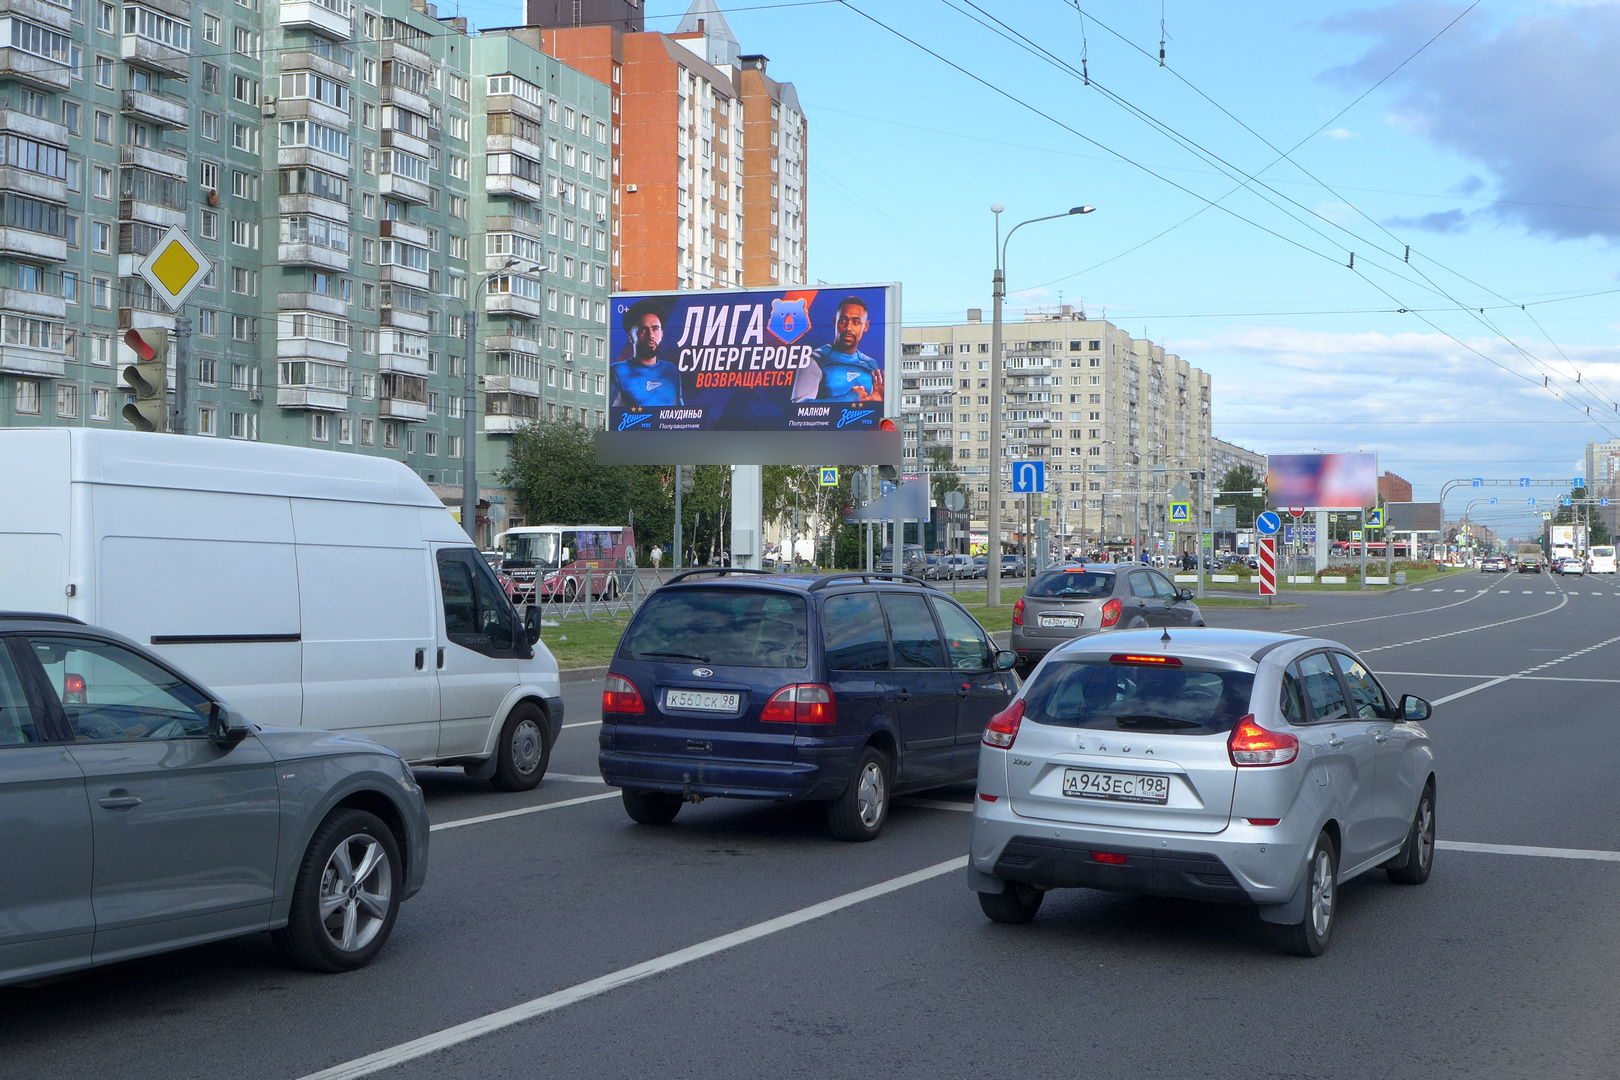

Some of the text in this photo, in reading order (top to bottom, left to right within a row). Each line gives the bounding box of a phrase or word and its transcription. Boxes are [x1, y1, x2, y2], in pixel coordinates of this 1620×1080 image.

[617, 304, 630, 314] 0+
[677, 304, 764, 348] ЛИГА
[678, 345, 813, 372] СУПЕРГЕРОЕВ
[695, 370, 795, 389] ВОЗВРАЩАЕТСЯ
[659, 409, 703, 420] КЛАУДИНЬО
[797, 407, 830, 417] МАЛКОМ
[659, 423, 700, 431] Полузащитник
[788, 420, 830, 428] Полузащитник
[722, 694, 735, 706] 98
[1078, 741, 1155, 755] LADA
[1068, 773, 1134, 795] А943ЕС
[1137, 776, 1163, 793] 198
